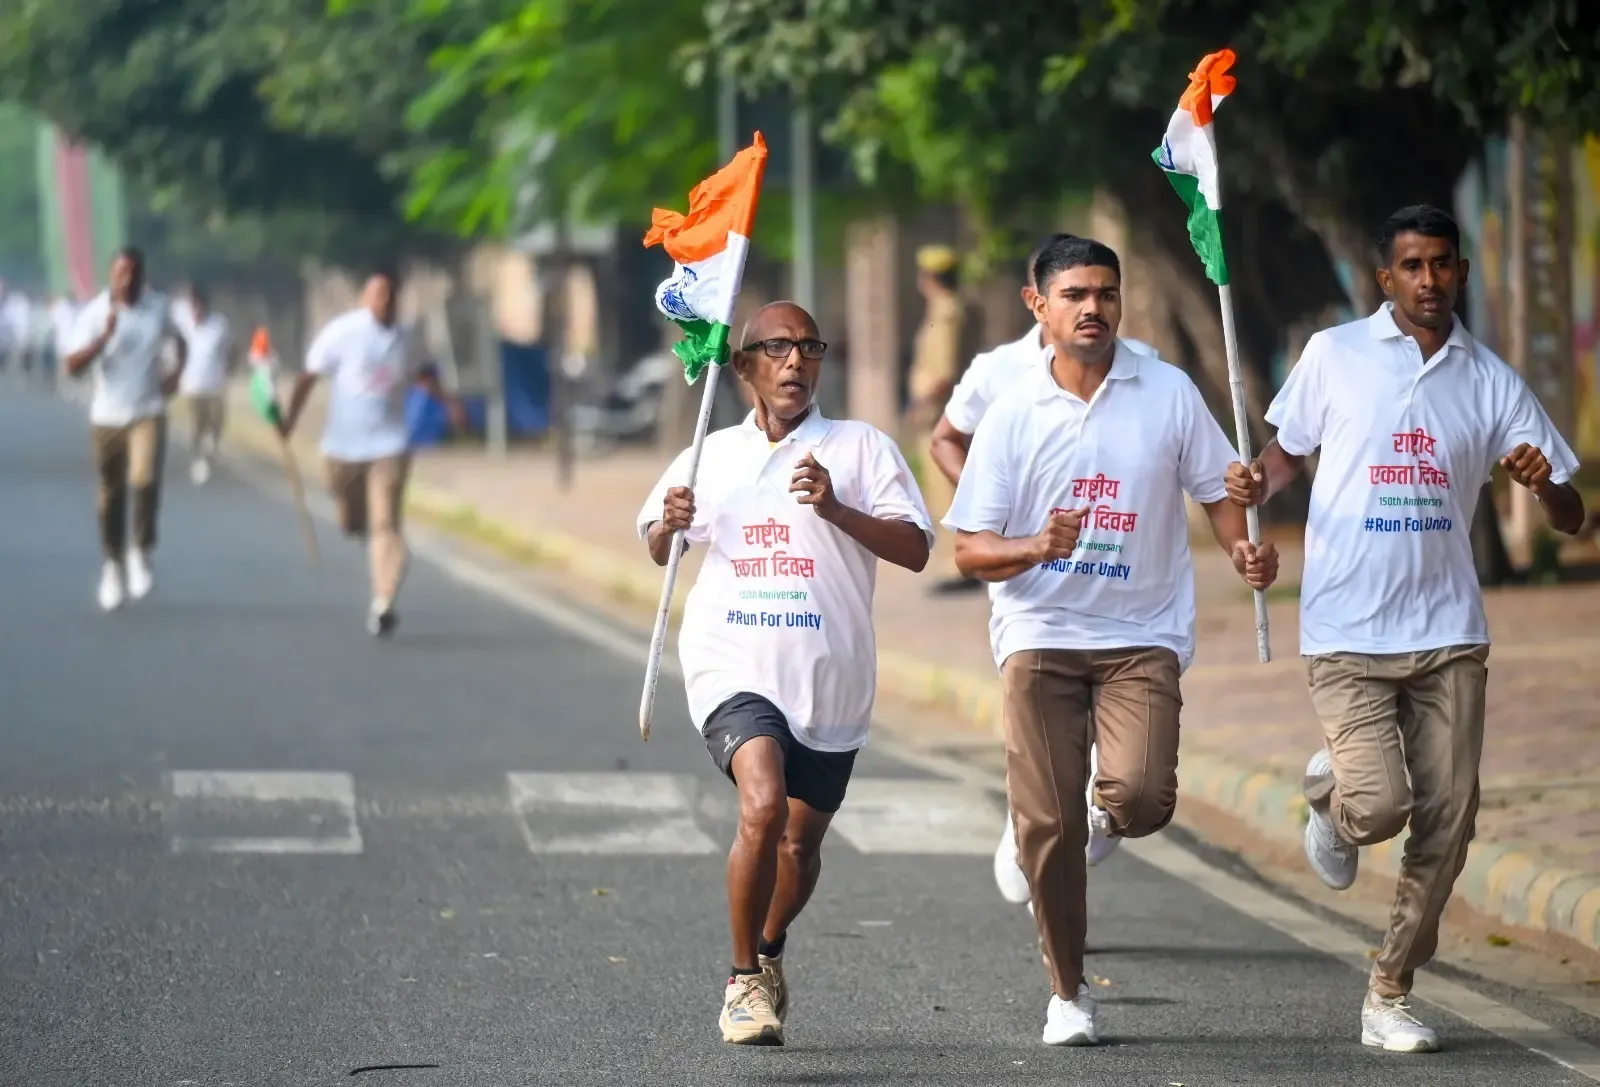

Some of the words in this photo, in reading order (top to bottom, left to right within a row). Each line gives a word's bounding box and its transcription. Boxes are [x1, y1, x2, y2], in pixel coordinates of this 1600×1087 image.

[1391, 428, 1437, 457] राष्ट्रीय
[1368, 465, 1415, 485] एकता
[1071, 473, 1120, 502] राष्ट्रीय
[1379, 496, 1402, 506] 150th
[1093, 505, 1138, 532] दिवस
[1364, 517, 1401, 532] #Run
[742, 517, 790, 548] राष्ट्रीय
[771, 550, 815, 578] दिवस
[1074, 560, 1096, 575] For
[1099, 561, 1131, 581] Unity
[758, 589, 808, 601] Anniversary
[726, 609, 757, 626] #Run
[760, 611, 782, 627] For
[786, 611, 822, 631] Unity
